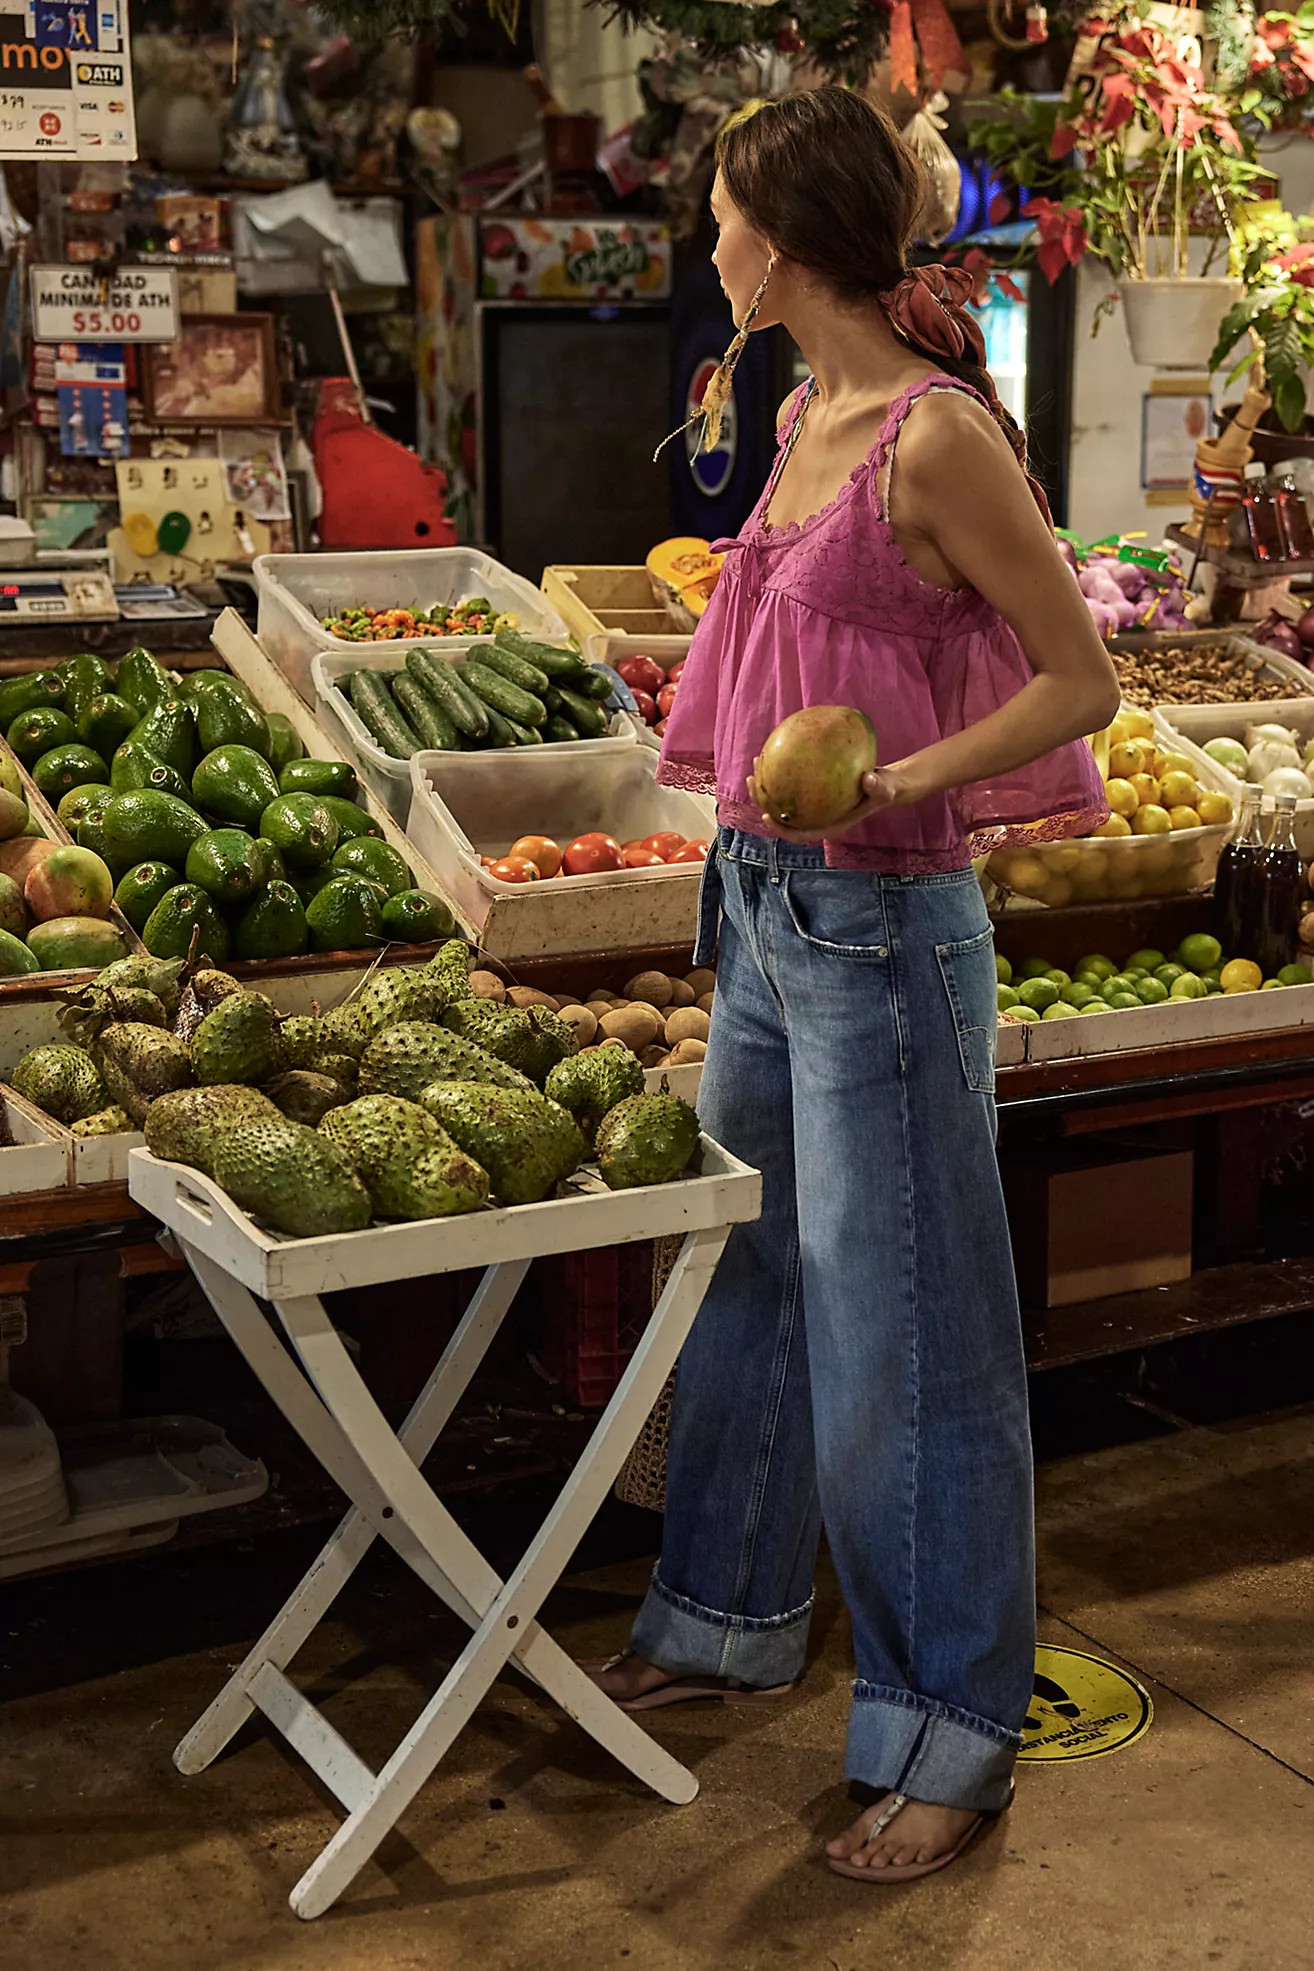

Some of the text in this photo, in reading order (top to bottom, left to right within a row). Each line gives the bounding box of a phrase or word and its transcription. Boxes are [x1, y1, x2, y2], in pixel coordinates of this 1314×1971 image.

[93, 67, 121, 81] ATH
[79, 102, 99, 110] VISA
[61, 273, 147, 290] CANDAD
[112, 292, 132, 308] DE
[138, 293, 171, 308] ATH
[73, 311, 141, 333] $5.00
[1058, 1730, 1109, 1749] SOCIAL
